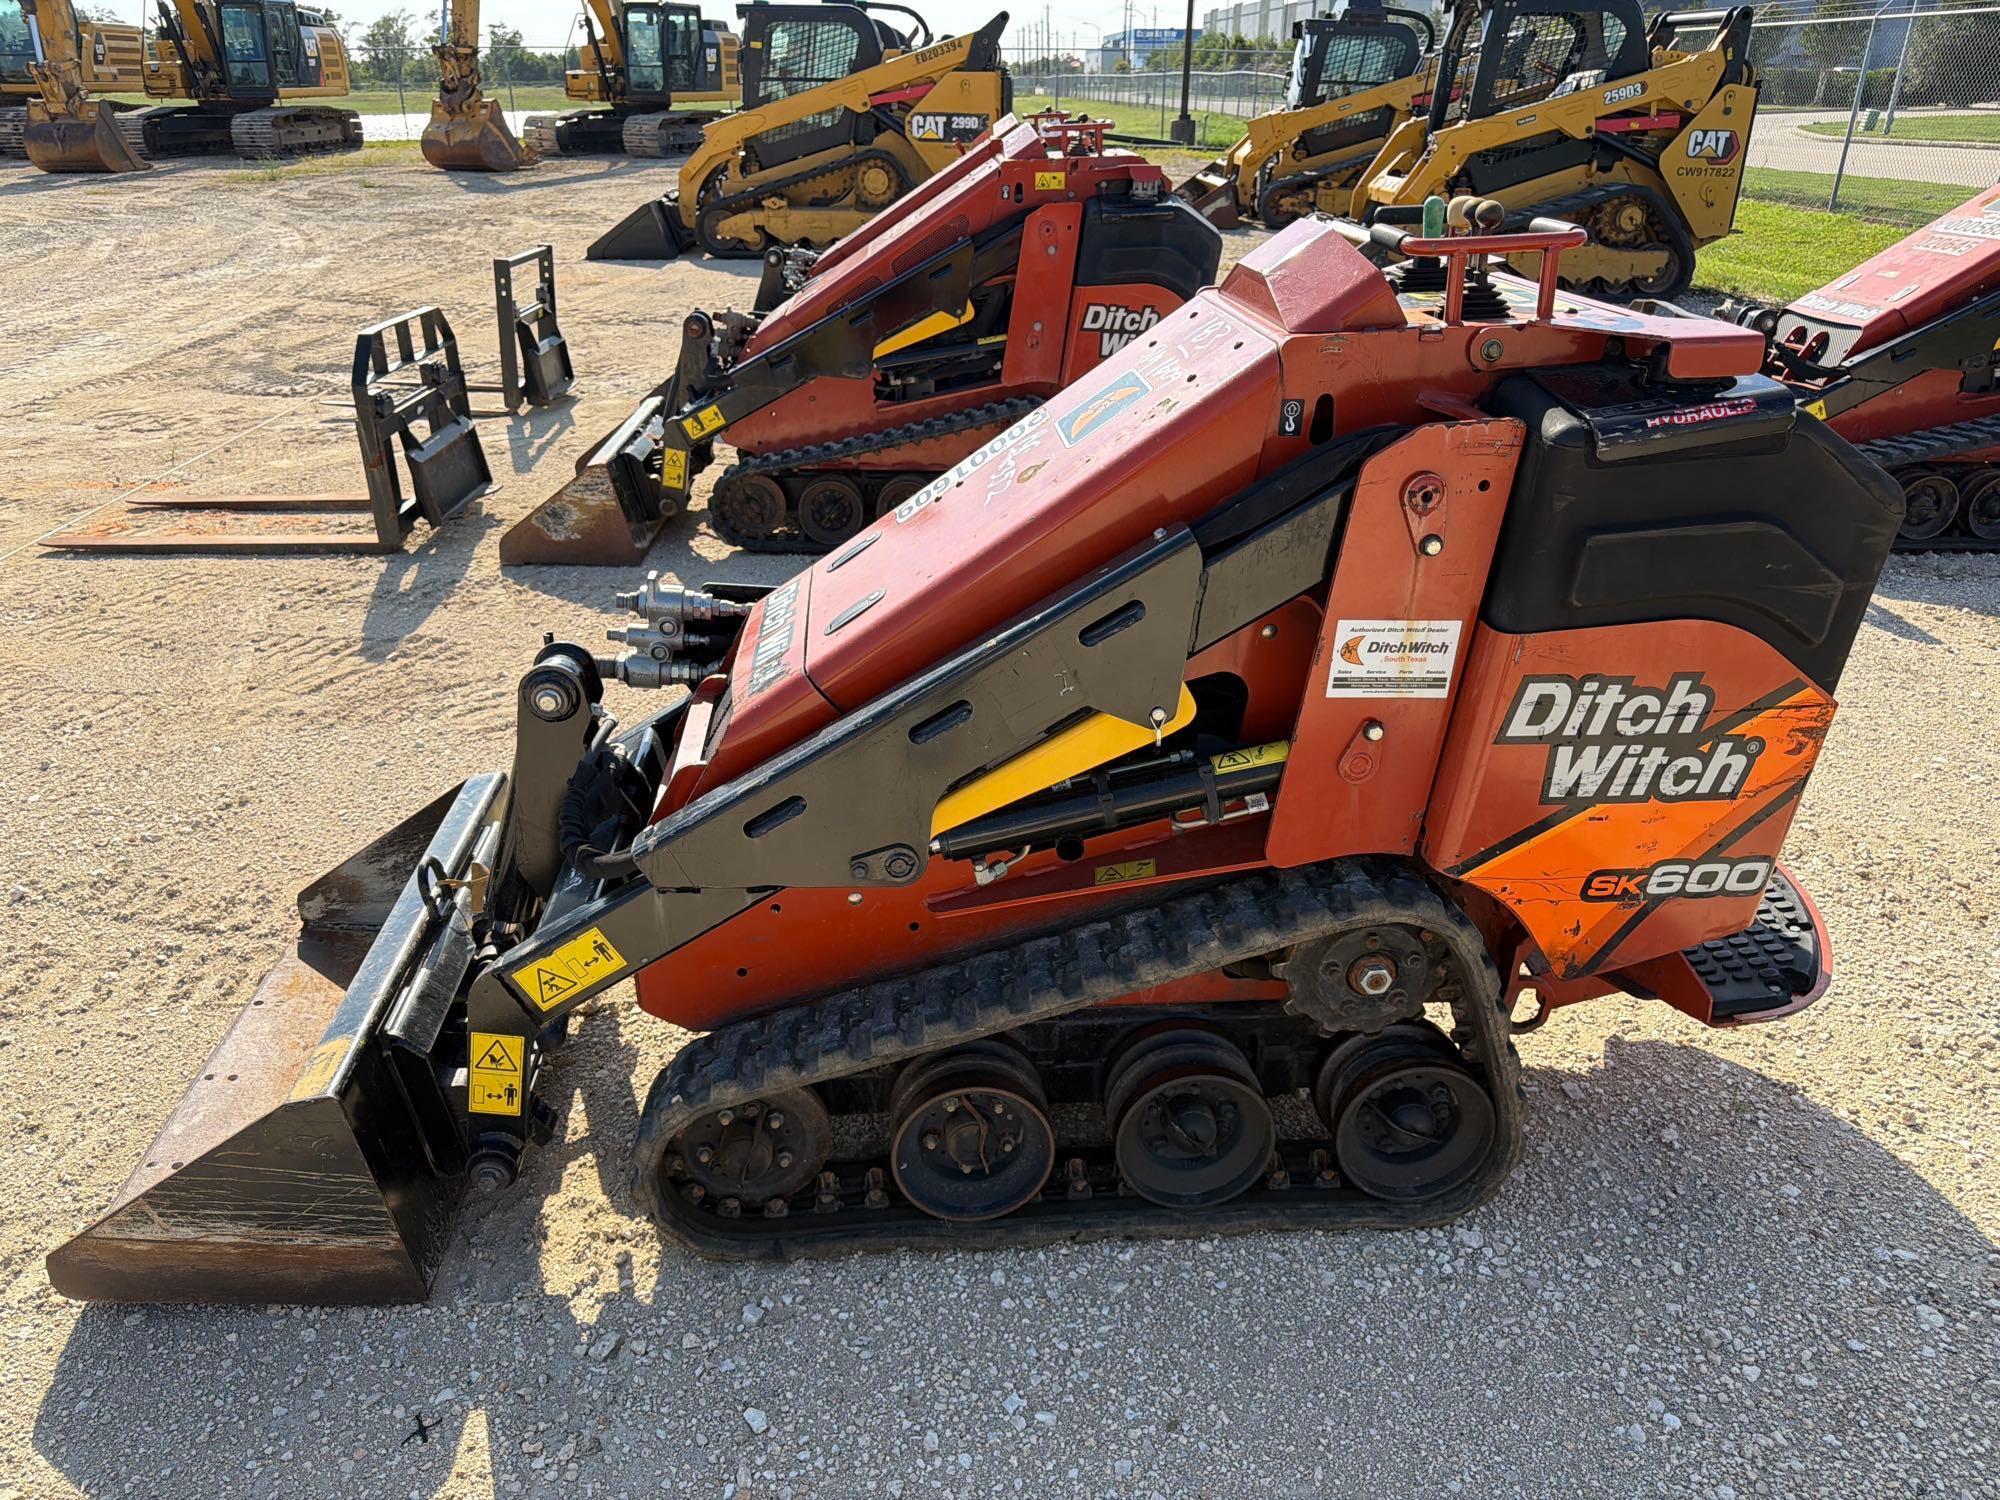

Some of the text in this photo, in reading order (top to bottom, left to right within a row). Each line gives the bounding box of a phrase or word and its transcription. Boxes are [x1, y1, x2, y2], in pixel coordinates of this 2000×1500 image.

[915, 39, 964, 64] FD203394
[1603, 84, 1643, 105] 259D3
[911, 115, 947, 139] CAT
[1688, 130, 1731, 158] CAT
[1676, 166, 1736, 178] CW917822
[1083, 305, 1159, 331] Ditch
[760, 580, 800, 639] Ditch
[1367, 641, 1450, 655] Ditch Witch
[1384, 655, 1406, 663] South
[1505, 680, 1707, 737] Ditch
[1587, 861, 1770, 897] SK600
